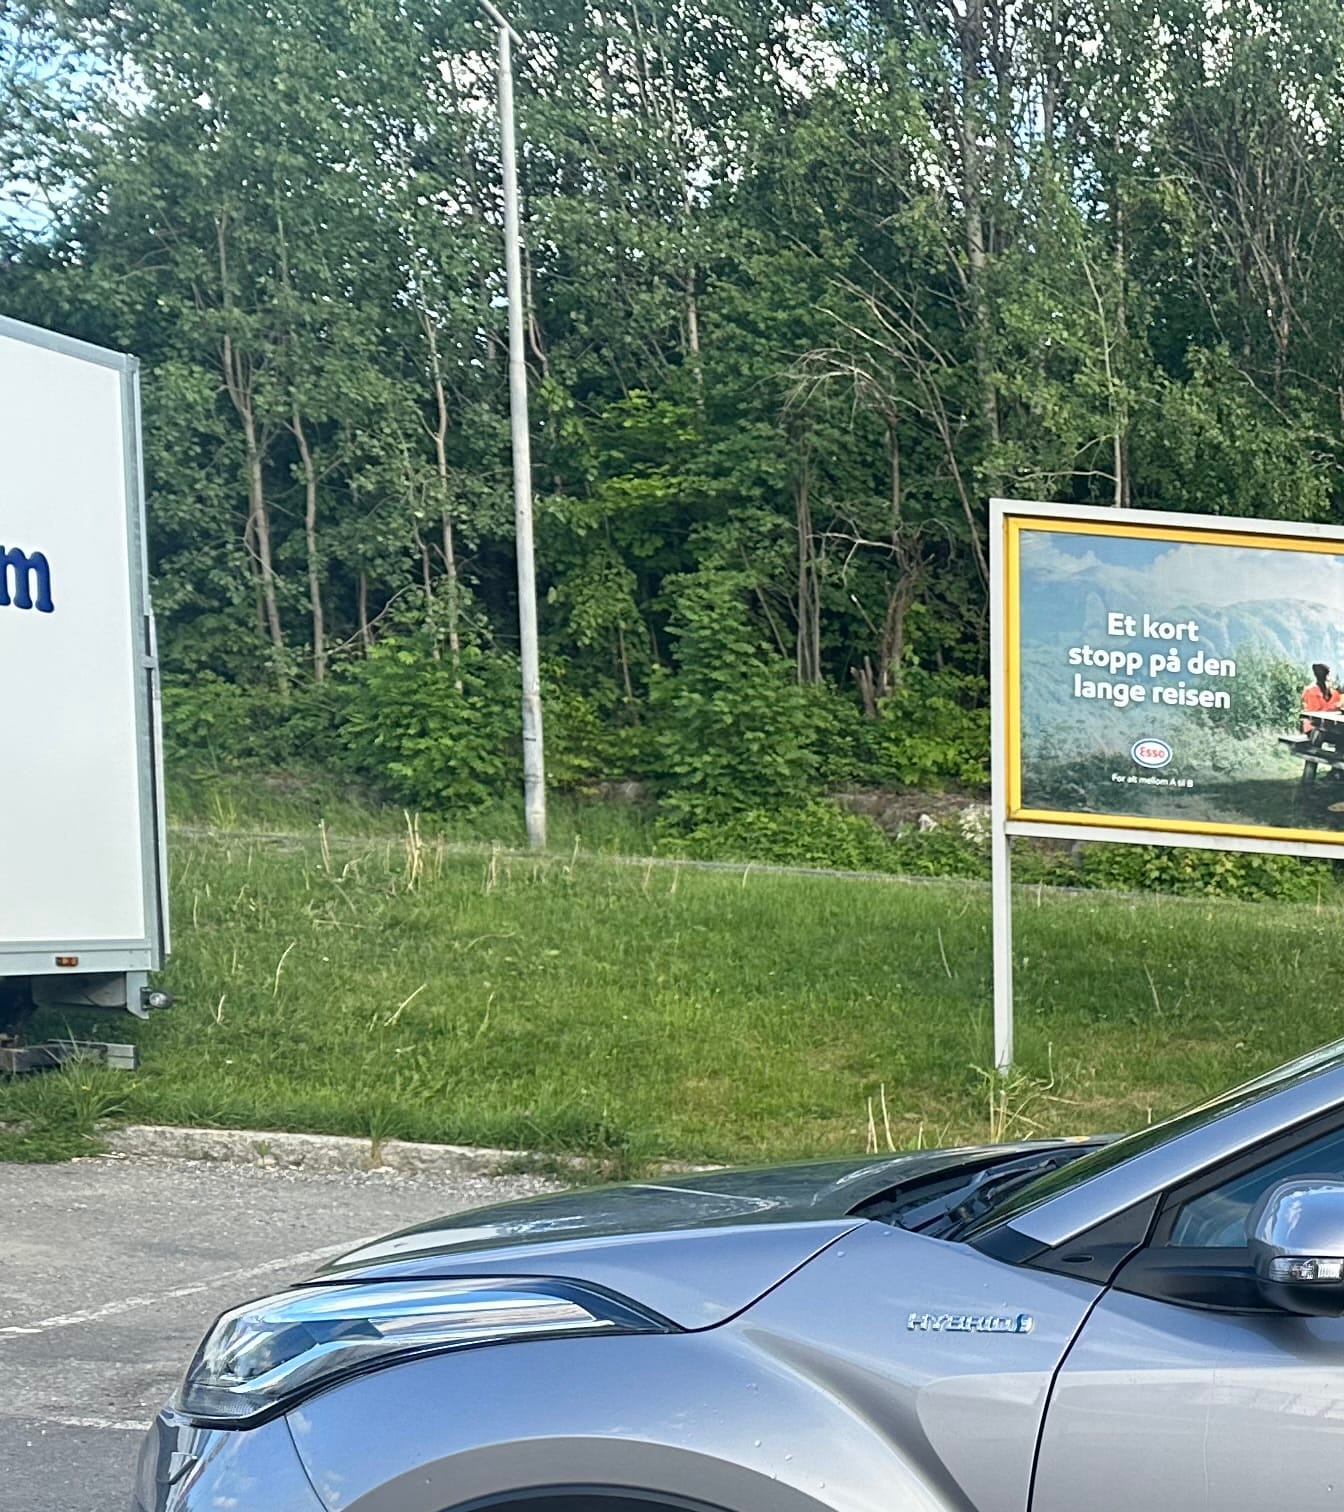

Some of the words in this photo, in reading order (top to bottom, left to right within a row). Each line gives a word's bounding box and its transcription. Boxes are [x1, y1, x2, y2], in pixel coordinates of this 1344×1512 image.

[1108, 612, 1137, 637] Et
[1143, 613, 1199, 641] kort
[1068, 645, 1143, 676] stopp
[1150, 648, 1181, 677] på
[1187, 650, 1236, 677] den
[1074, 673, 1146, 707] lange
[1152, 681, 1231, 709] reisen
[1139, 776, 1168, 785] mellom
[1169, 778, 1177, 786] A
[1187, 779, 1194, 788] B
